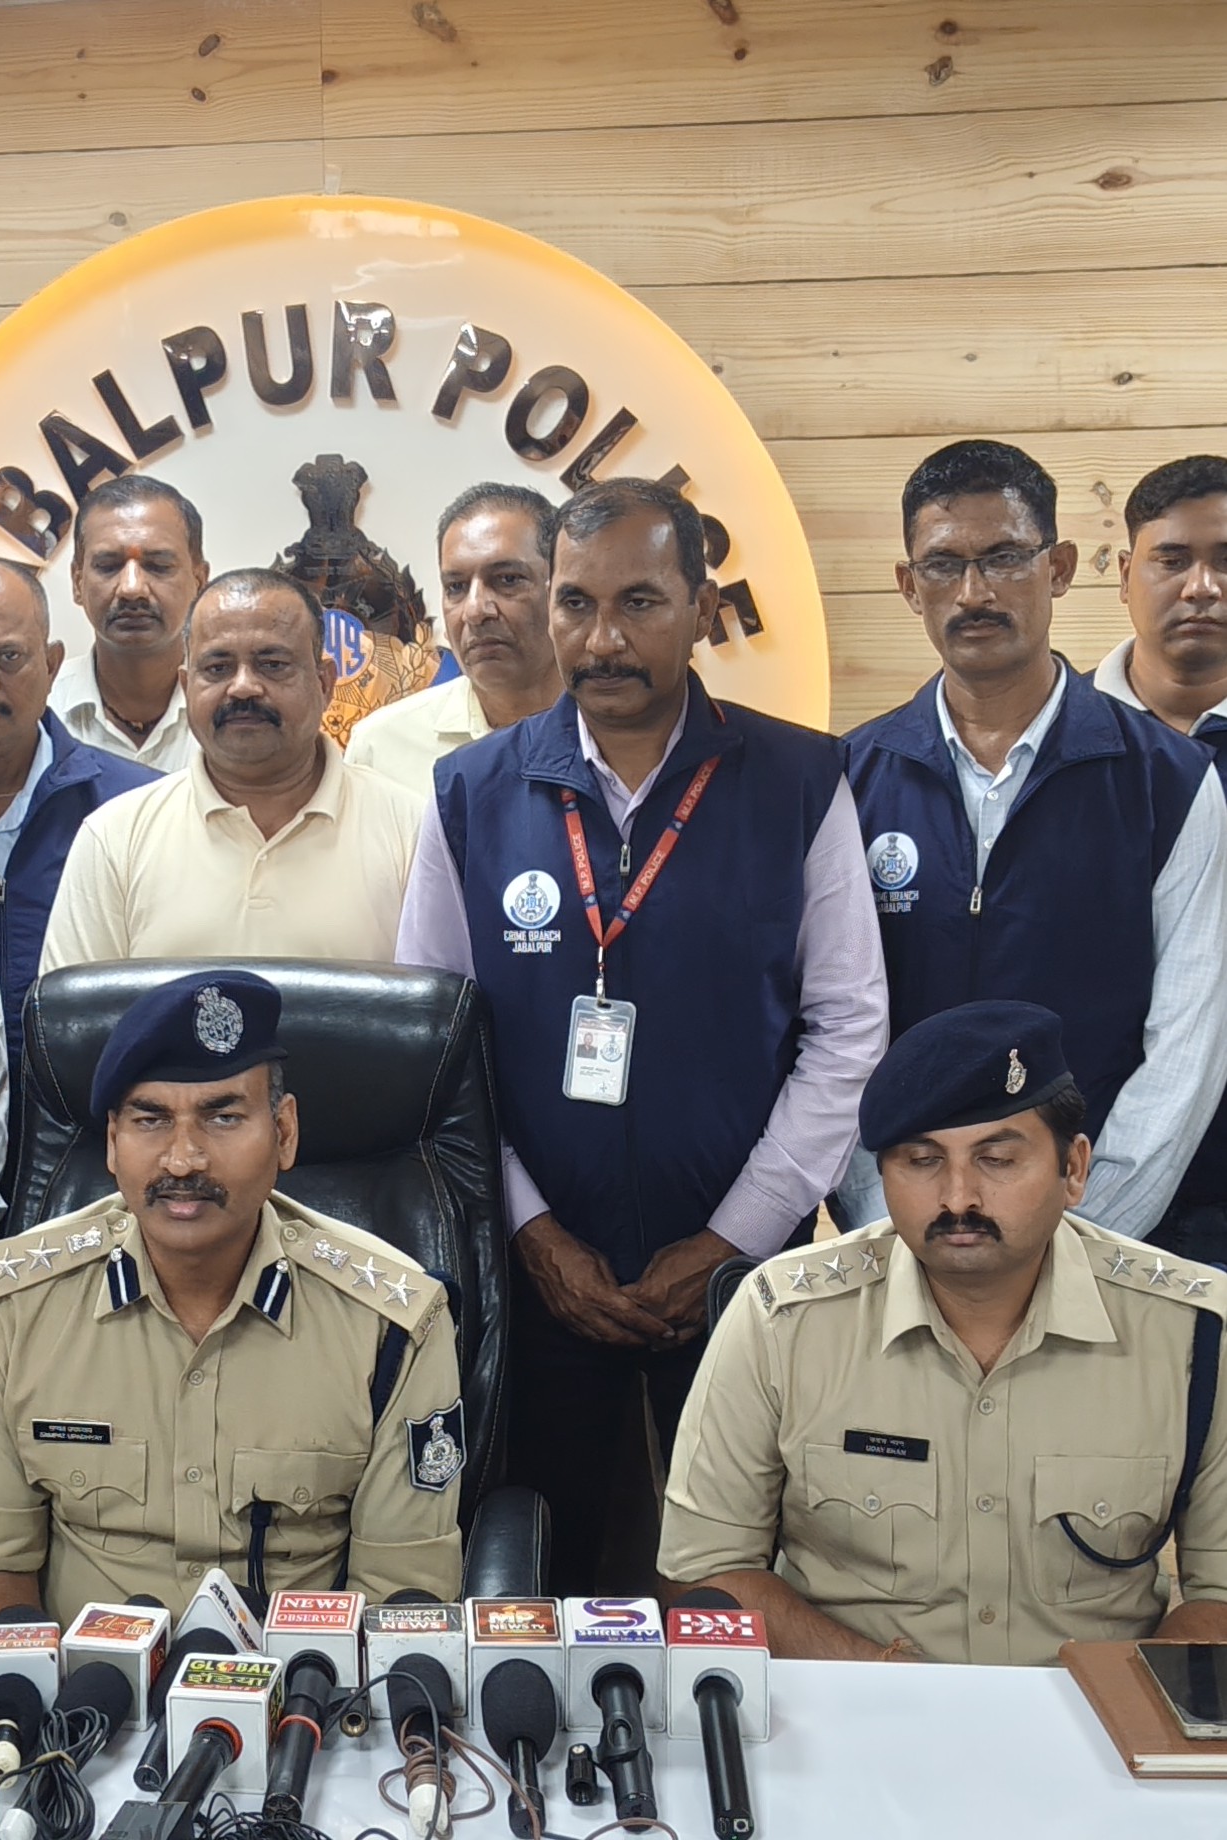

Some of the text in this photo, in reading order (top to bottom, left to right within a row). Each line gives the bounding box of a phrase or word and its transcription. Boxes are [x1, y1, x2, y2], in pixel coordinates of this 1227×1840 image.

[572, 832, 586, 868] POLICE
[640, 850, 666, 886] POLICE
[503, 929, 561, 942] CRIME BRANCH
[512, 941, 553, 953] JABALPUR
[282, 1597, 350, 1609] NEWS
[276, 1613, 346, 1624] OBSERVER
[489, 1611, 535, 1623] MP
[381, 1621, 441, 1630] NEWS
[491, 1622, 530, 1631] NEWS
[678, 1613, 756, 1637] DM
[578, 1629, 656, 1637] SHREY TV
[189, 1660, 273, 1674] GLOBAL
